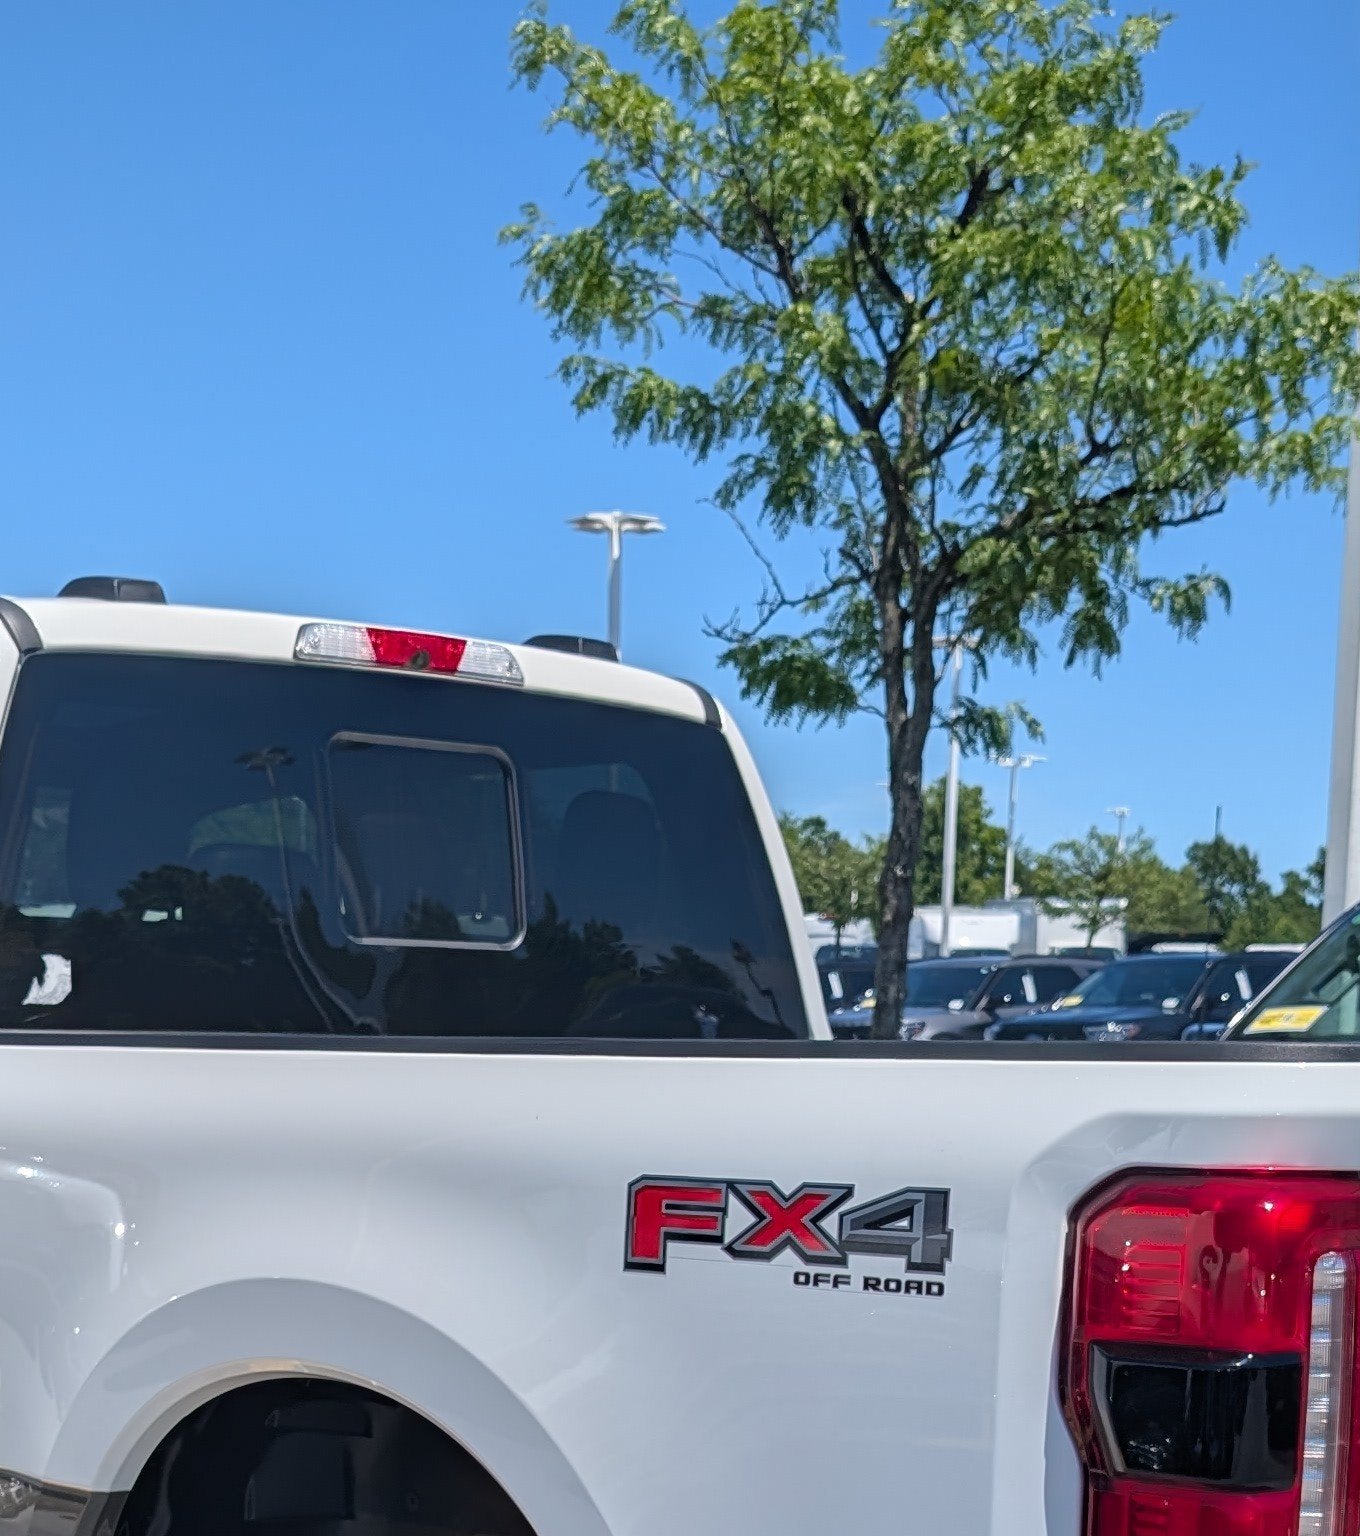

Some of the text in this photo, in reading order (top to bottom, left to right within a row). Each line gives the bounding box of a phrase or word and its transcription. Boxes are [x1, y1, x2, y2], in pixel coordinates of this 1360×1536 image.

[624, 1174, 953, 1275] FX4
[793, 1271, 945, 1298] OFF ROAD
